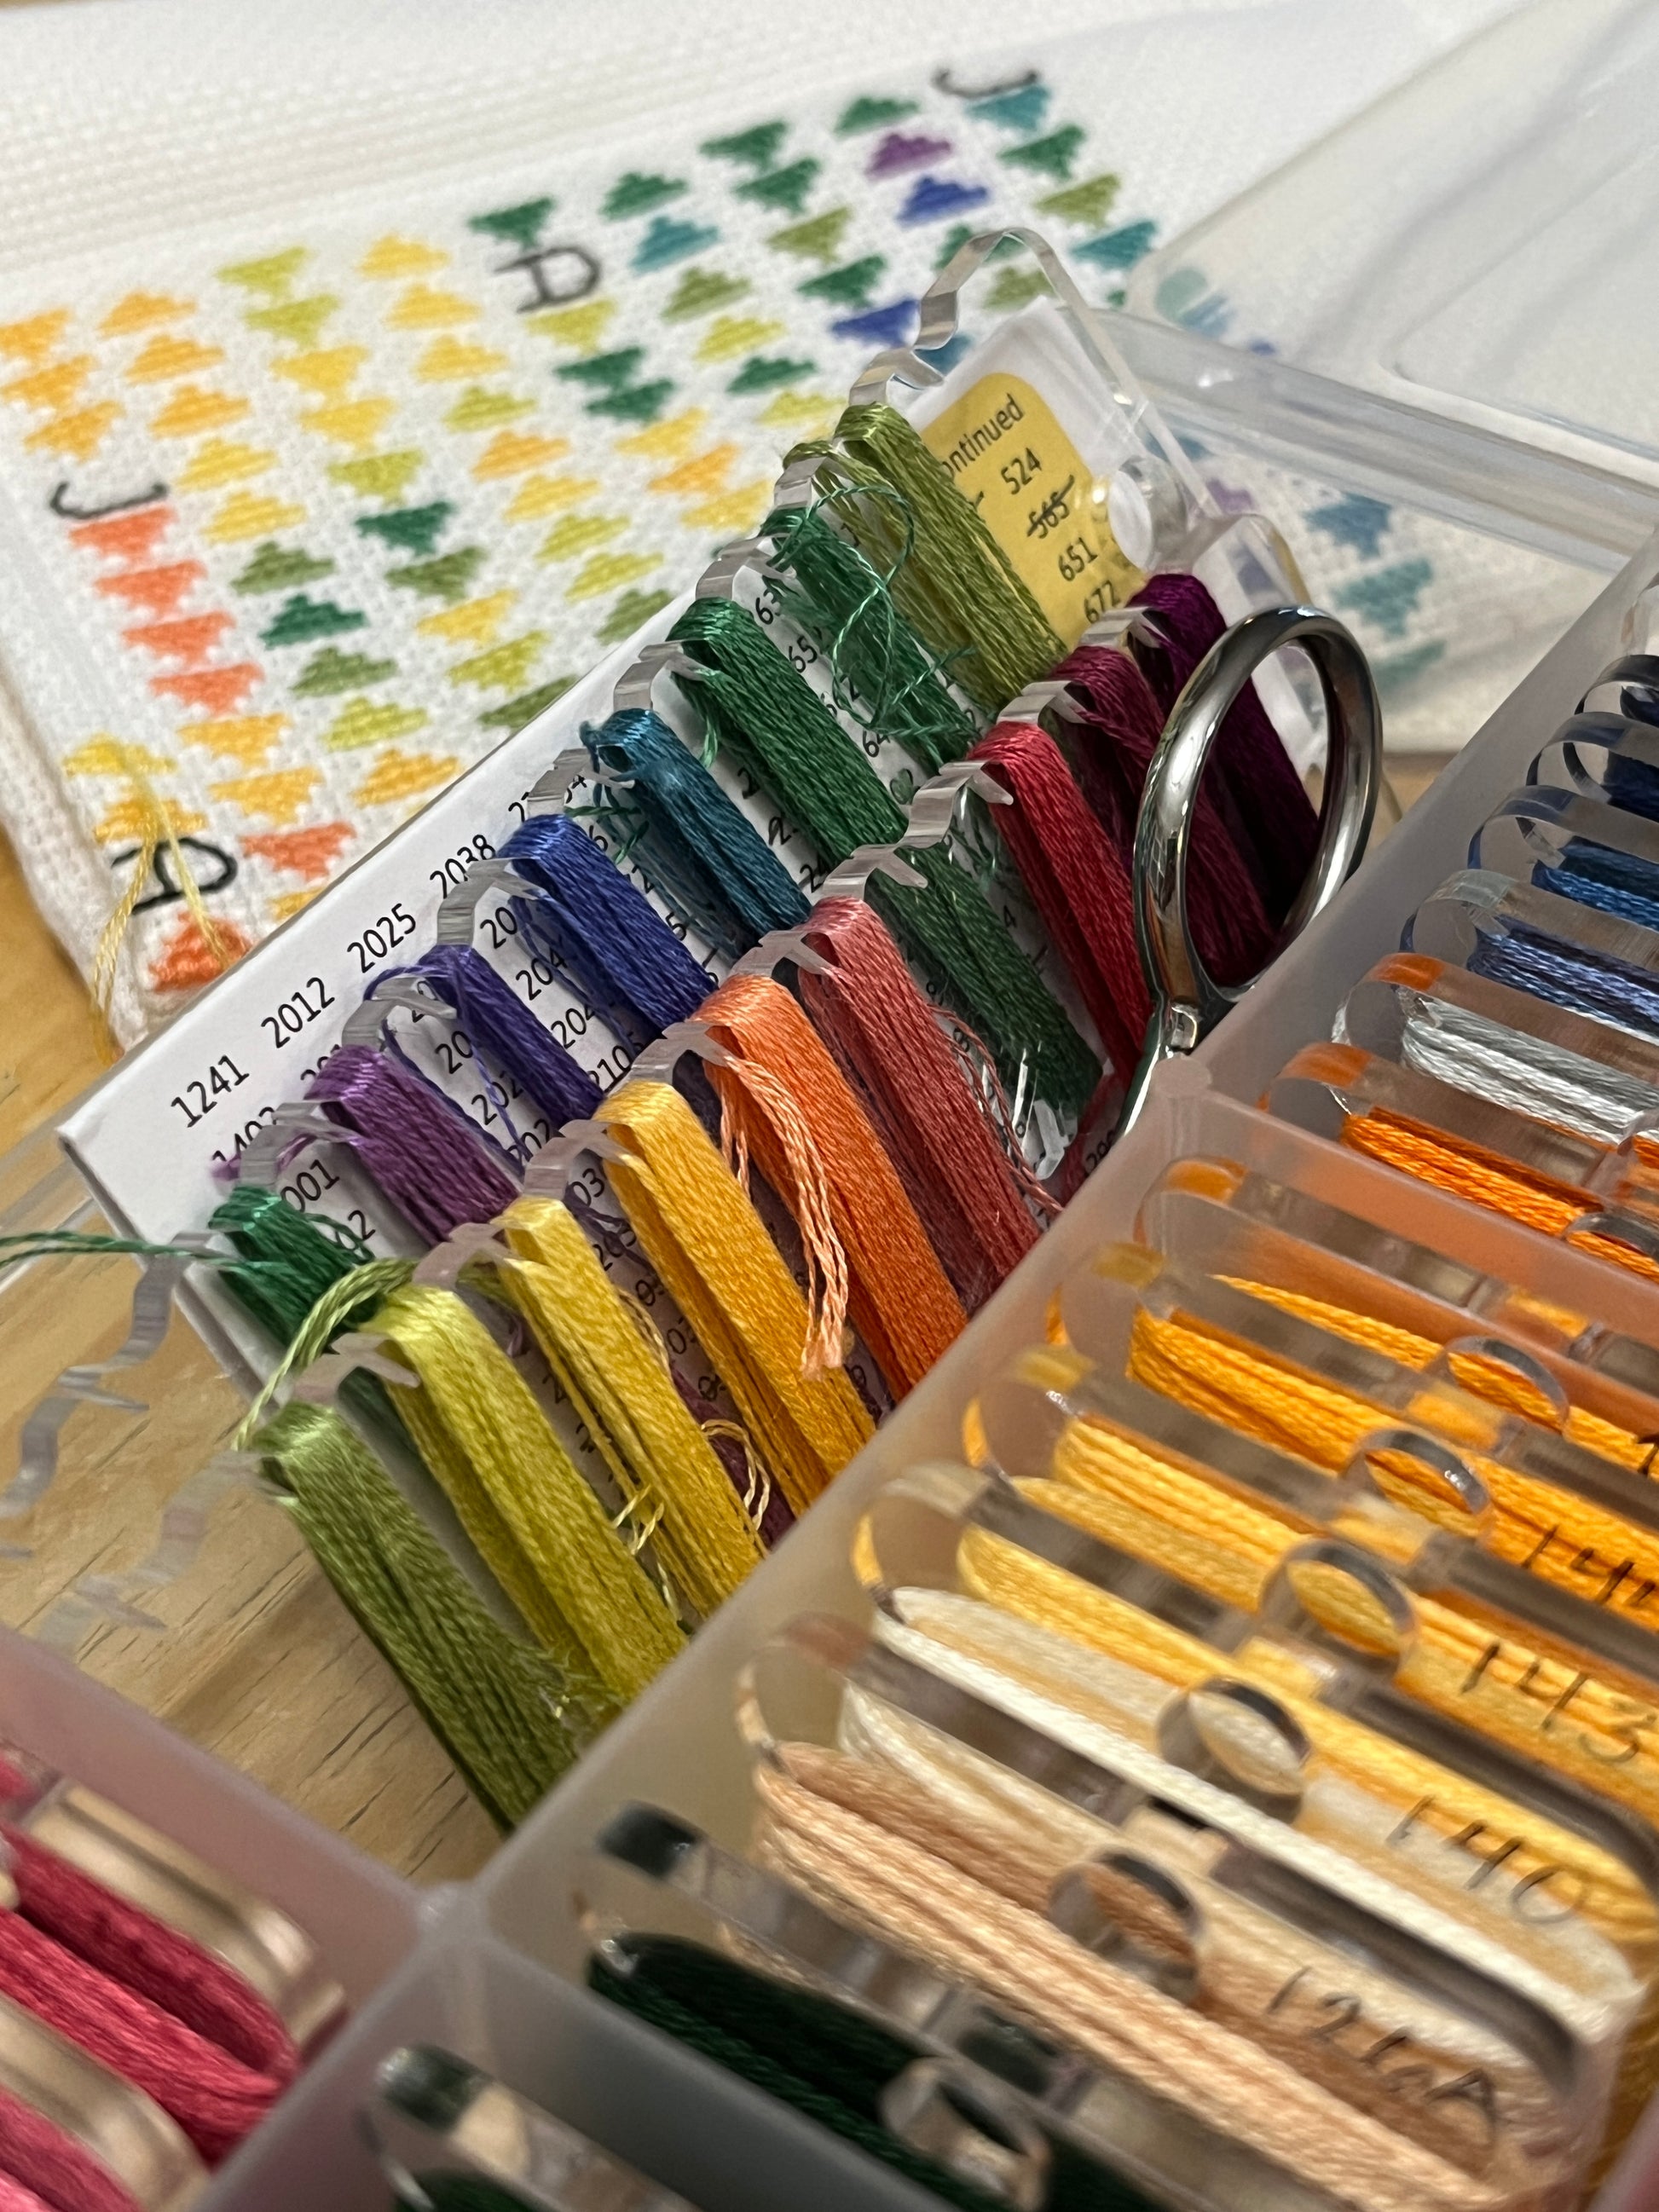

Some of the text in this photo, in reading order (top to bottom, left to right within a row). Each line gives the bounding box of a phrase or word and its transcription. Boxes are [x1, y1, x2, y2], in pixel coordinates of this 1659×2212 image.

[942, 392, 1024, 477] ontinued
[1001, 448, 1043, 496] 524
[1058, 537, 1098, 581] 651
[1084, 580, 1122, 624] 672
[171, 1055, 249, 1127] 1241
[261, 977, 334, 1048] 2012
[346, 903, 416, 973] 2025
[429, 834, 499, 898] 2038
[280, 1157, 344, 1218] 001
[1460, 1644, 1657, 1761] 143
[1385, 1794, 1587, 1924] 140
